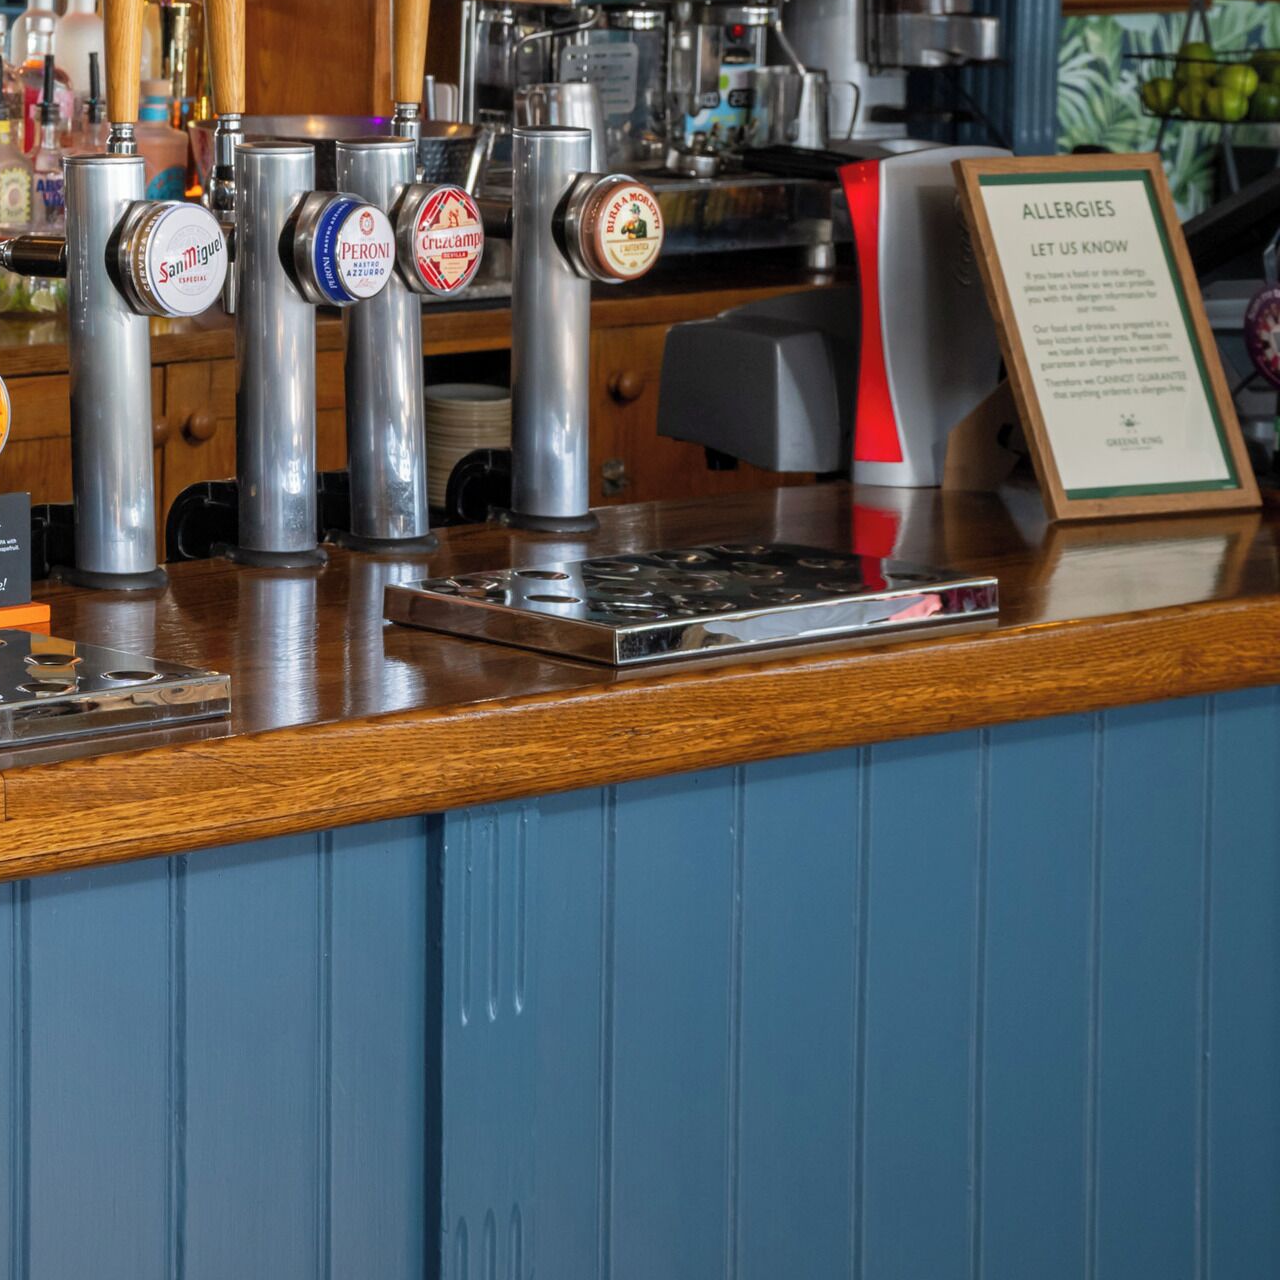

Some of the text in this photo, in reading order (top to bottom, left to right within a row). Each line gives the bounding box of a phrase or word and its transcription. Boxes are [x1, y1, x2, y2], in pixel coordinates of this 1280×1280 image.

[606, 196, 629, 234] BIRRA
[1022, 200, 1117, 220] ALLERGIES
[341, 241, 390, 260] PERONI
[1031, 239, 1129, 257] LET US KNOW
[158, 232, 223, 284] San Miguel
[353, 261, 380, 269] NASTRO
[178, 274, 208, 284] ESPECIAL
[324, 256, 338, 290] PERONI
[346, 268, 385, 277] AZZURRO
